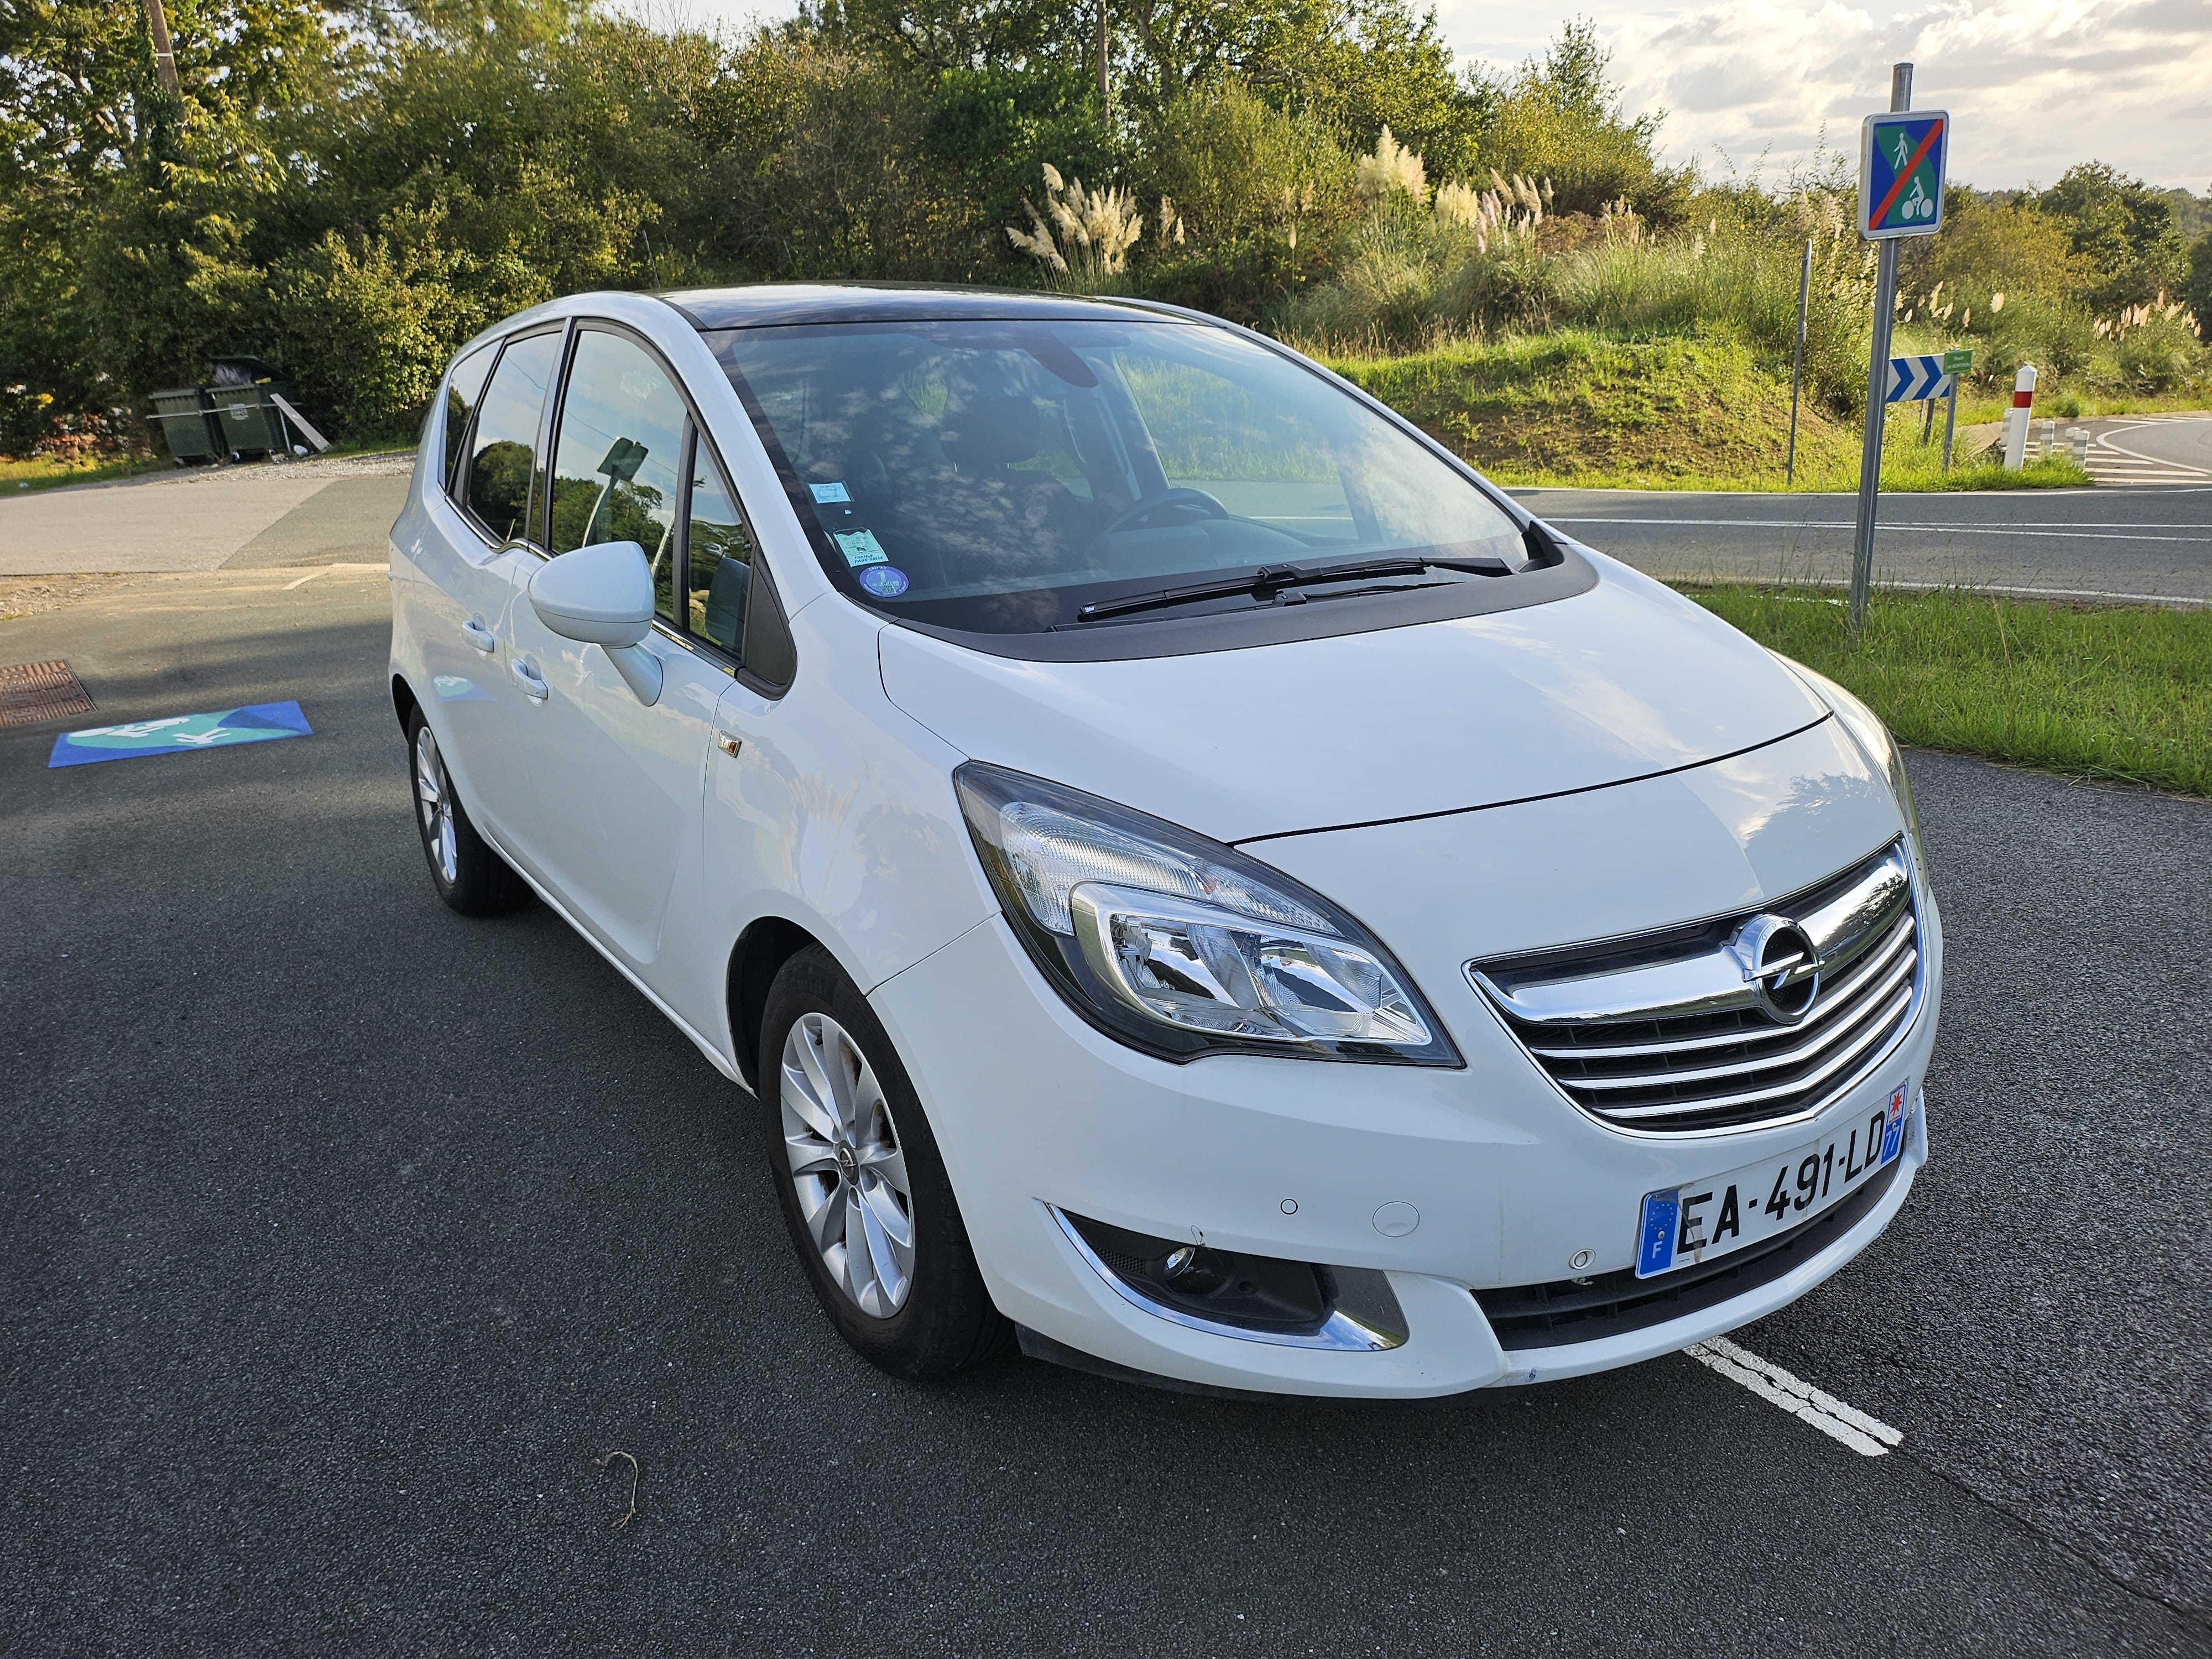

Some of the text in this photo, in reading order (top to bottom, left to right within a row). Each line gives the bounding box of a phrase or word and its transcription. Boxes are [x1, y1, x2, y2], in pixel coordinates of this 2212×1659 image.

[877, 571, 886, 582] 1
[1883, 1125, 1900, 1157] 77
[1677, 1110, 1885, 1255] EA-491-LD
[1652, 1240, 1662, 1259] F
